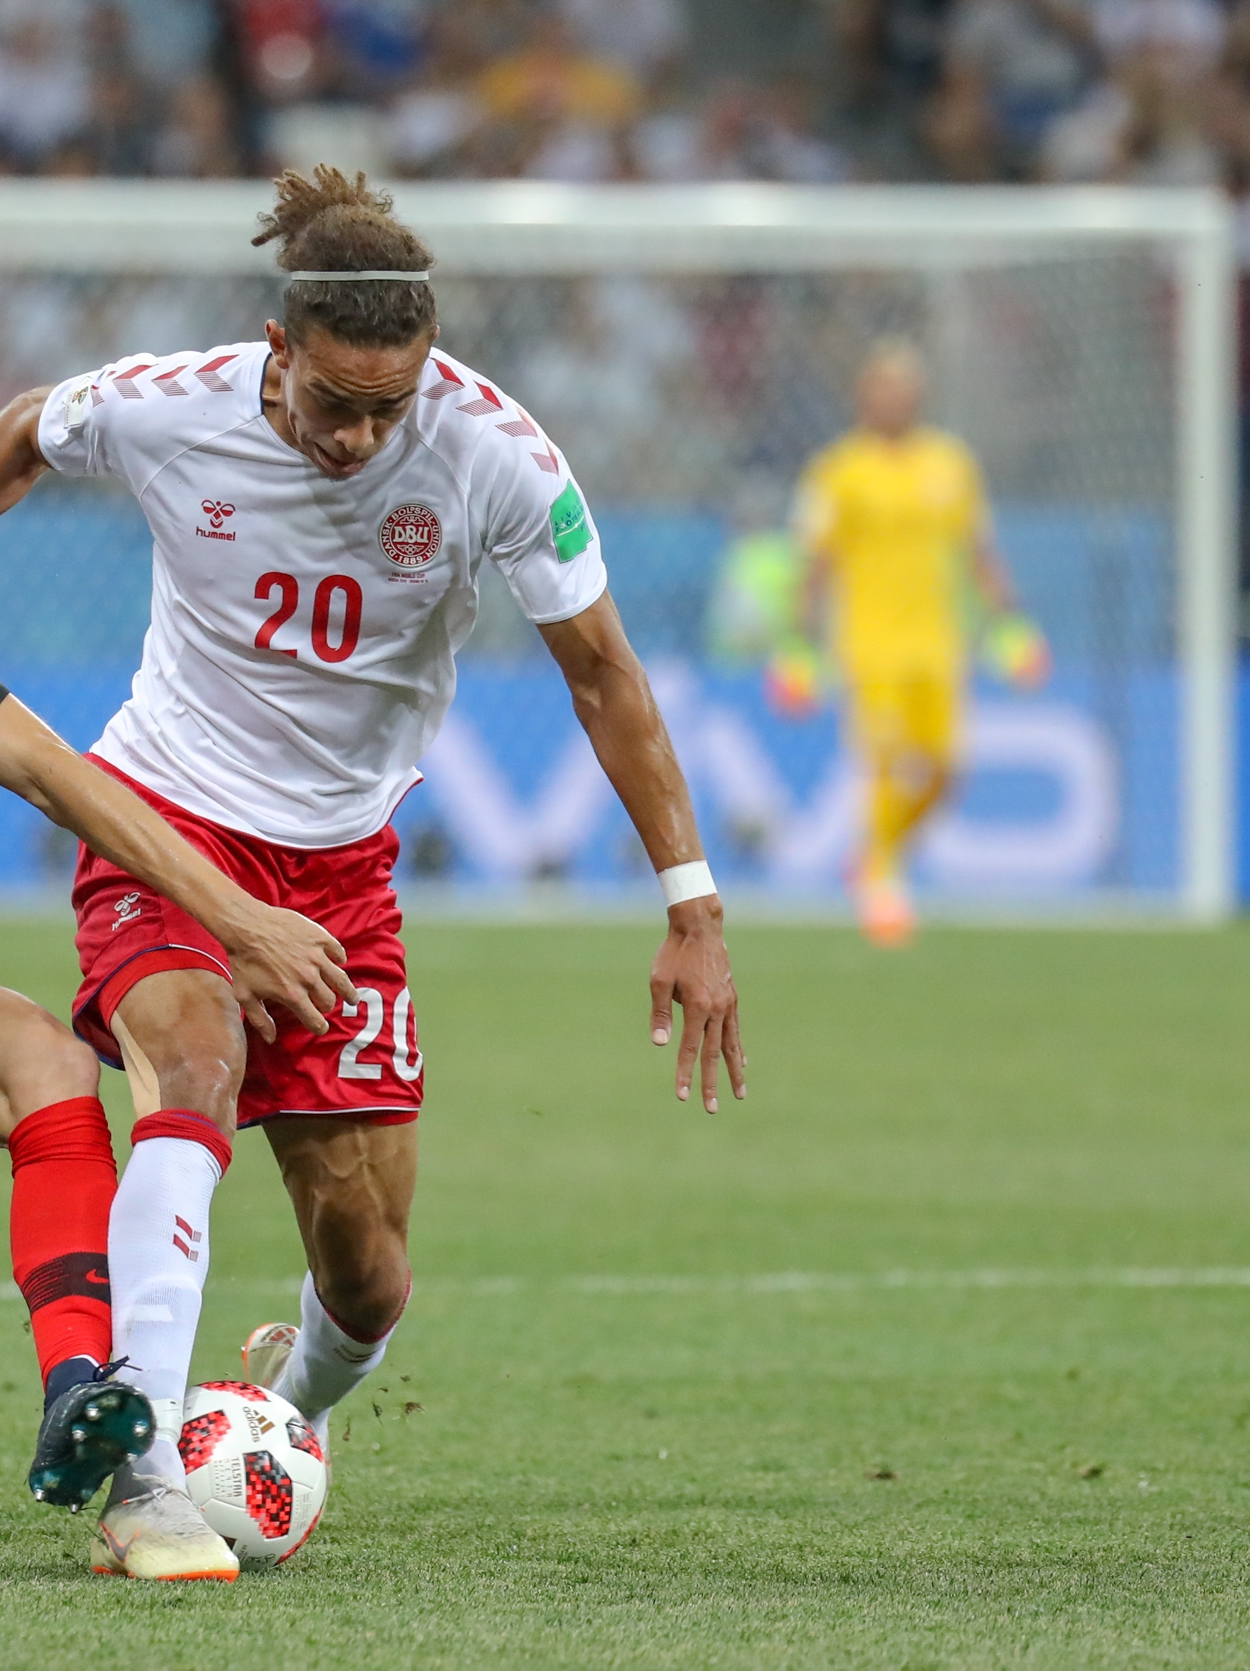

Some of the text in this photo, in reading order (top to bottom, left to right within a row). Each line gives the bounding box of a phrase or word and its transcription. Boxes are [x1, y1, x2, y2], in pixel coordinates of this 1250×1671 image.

[196, 526, 236, 541] hummel
[382, 522, 397, 557] DANSK
[392, 525, 430, 544] DBU
[398, 555, 424, 565] 1889
[254, 571, 362, 663] 20
[338, 986, 423, 1081] 20
[243, 1406, 260, 1443] adidas
